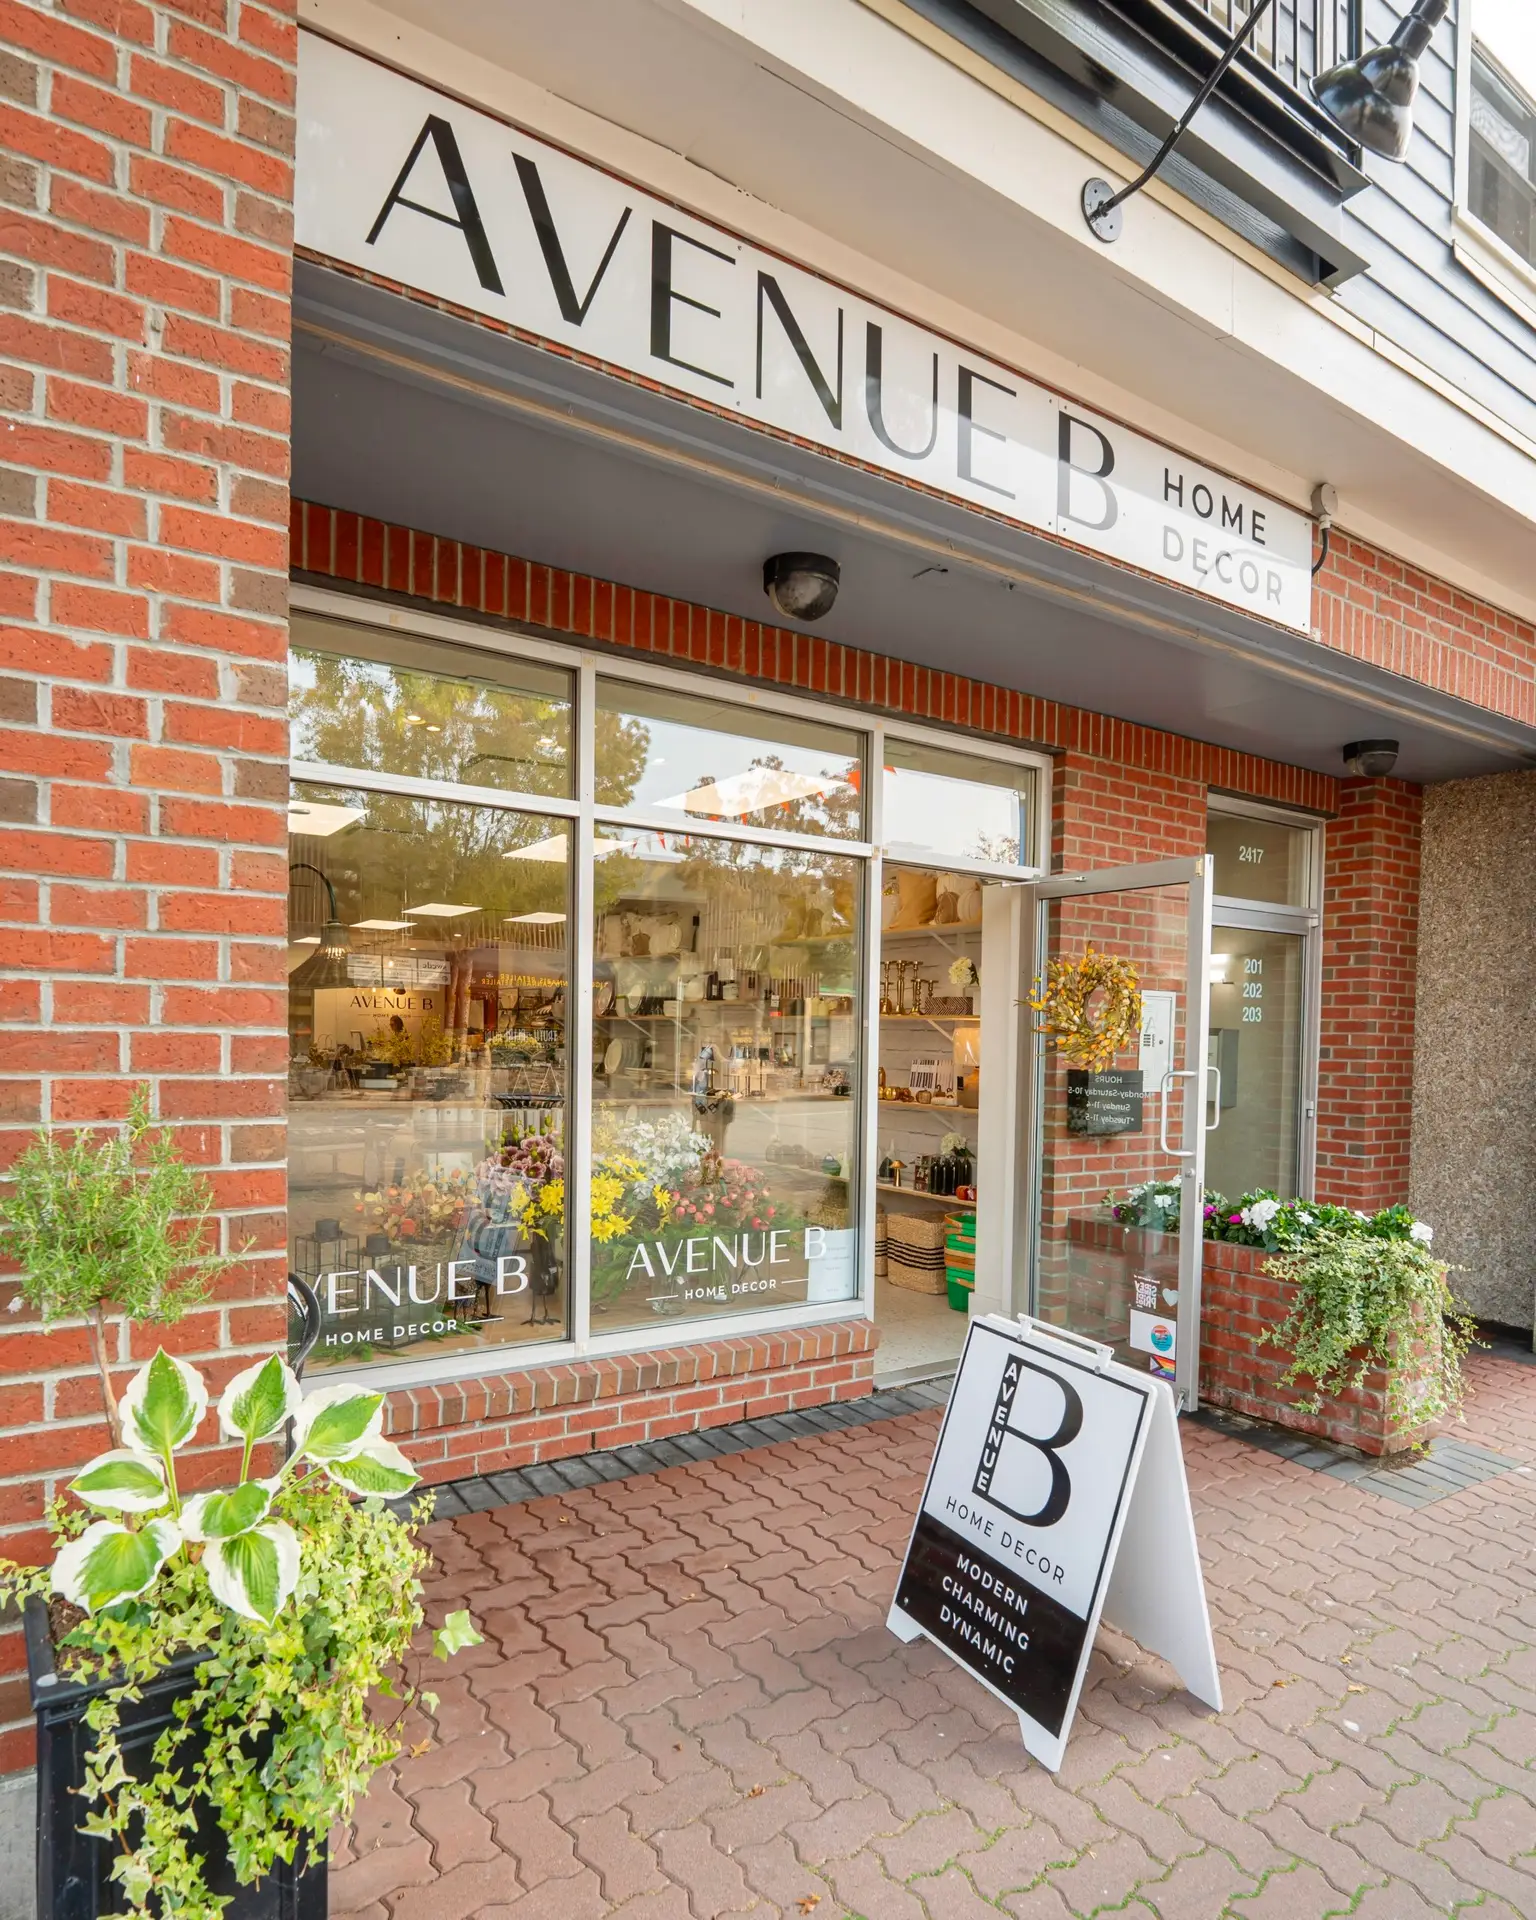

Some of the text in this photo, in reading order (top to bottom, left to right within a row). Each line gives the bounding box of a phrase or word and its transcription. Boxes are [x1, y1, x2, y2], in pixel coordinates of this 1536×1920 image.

[365, 113, 1118, 531] AVENUE B
[1164, 467, 1266, 546] HOME
[1163, 524, 1283, 605] DECOR
[1238, 845, 1264, 864] 2417
[1242, 982, 1262, 999] 202
[1243, 958, 1263, 974] 201
[350, 995, 434, 1011] AVENUE B
[1242, 1006, 1262, 1023] 203
[626, 1226, 827, 1280] AVENUE B
[288, 1255, 529, 1320] VENUE B
[685, 1278, 777, 1300] HOME DECOR
[325, 1319, 457, 1347] HOME DECOR
[972, 1353, 1084, 1528] B
[976, 1362, 1018, 1492] AVENUE
[945, 1495, 1065, 1585] HOME DECOR
[942, 1575, 1030, 1650] CHARMING
[956, 1553, 1029, 1616] MODERN
[940, 1604, 1015, 1674] DYNAMIC
